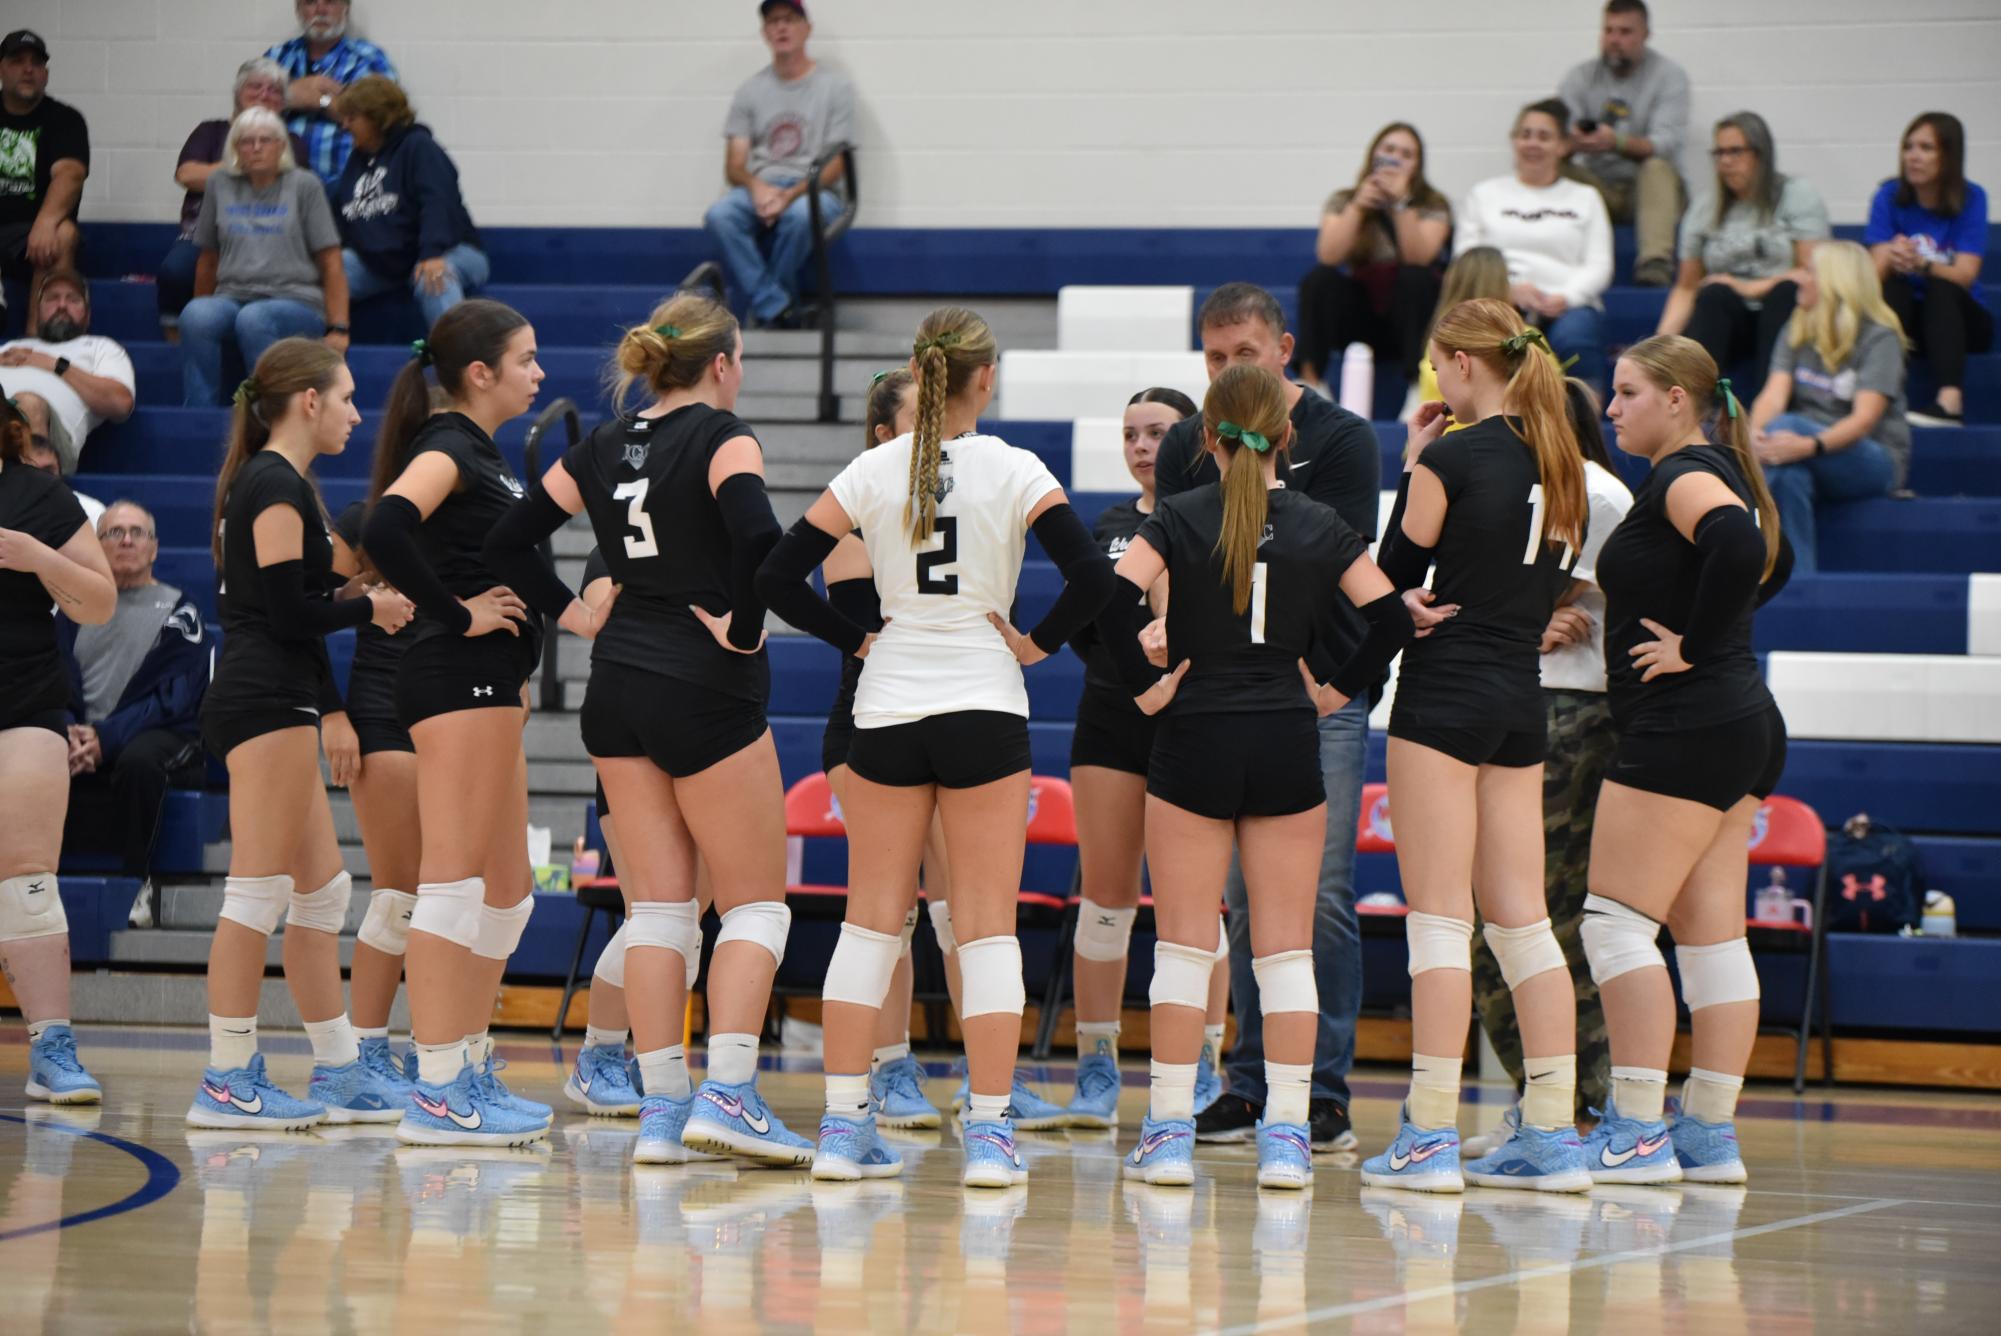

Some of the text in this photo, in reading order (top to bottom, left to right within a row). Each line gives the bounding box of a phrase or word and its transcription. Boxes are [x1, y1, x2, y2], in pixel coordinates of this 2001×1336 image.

[613, 477, 659, 559] 3
[917, 516, 959, 595] 2
[1251, 561, 1268, 644] 1
